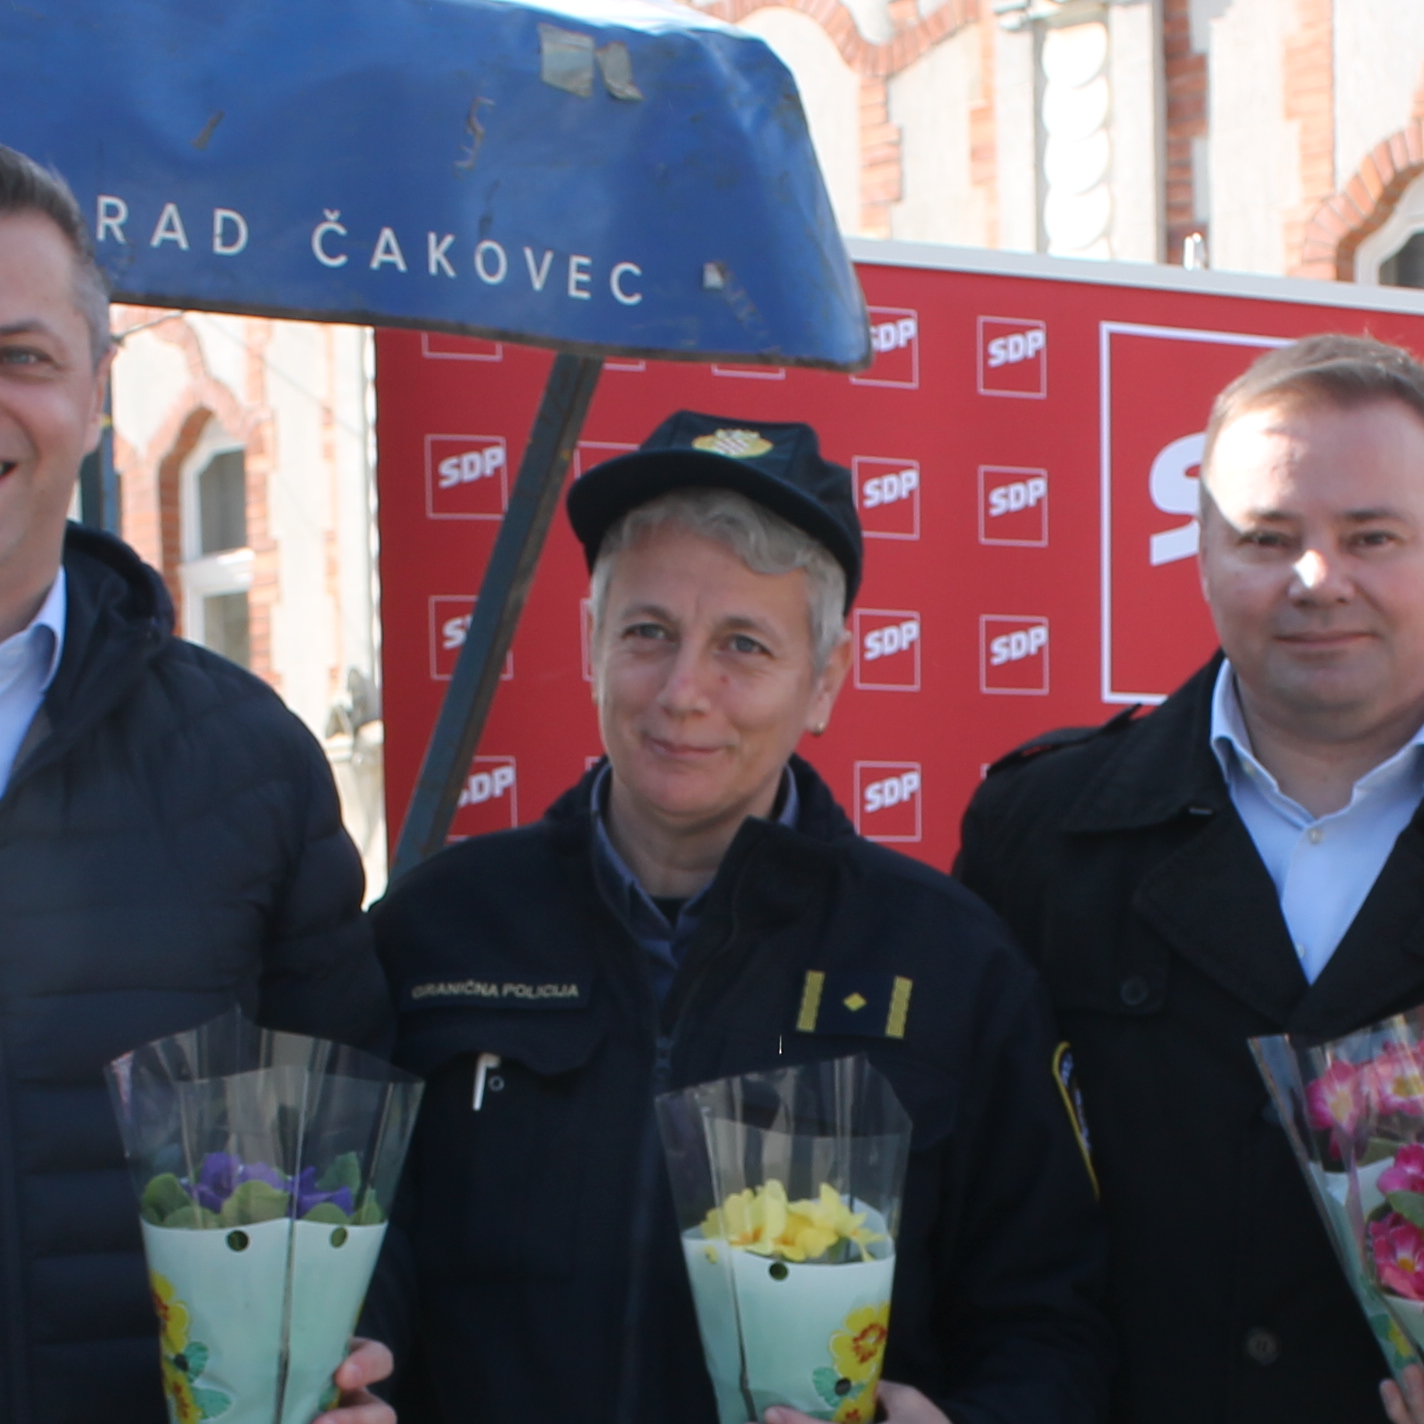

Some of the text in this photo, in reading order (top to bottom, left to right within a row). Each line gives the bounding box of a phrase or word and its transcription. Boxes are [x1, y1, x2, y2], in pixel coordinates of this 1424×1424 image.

[311, 209, 643, 305] ČAKOVEC
[988, 329, 1046, 368] SDP
[438, 445, 506, 489] SDP
[863, 468, 918, 508] SDP
[989, 477, 1047, 517] SDP
[864, 619, 919, 661] SDP
[991, 625, 1048, 666] SDP
[864, 771, 920, 813] SDP
